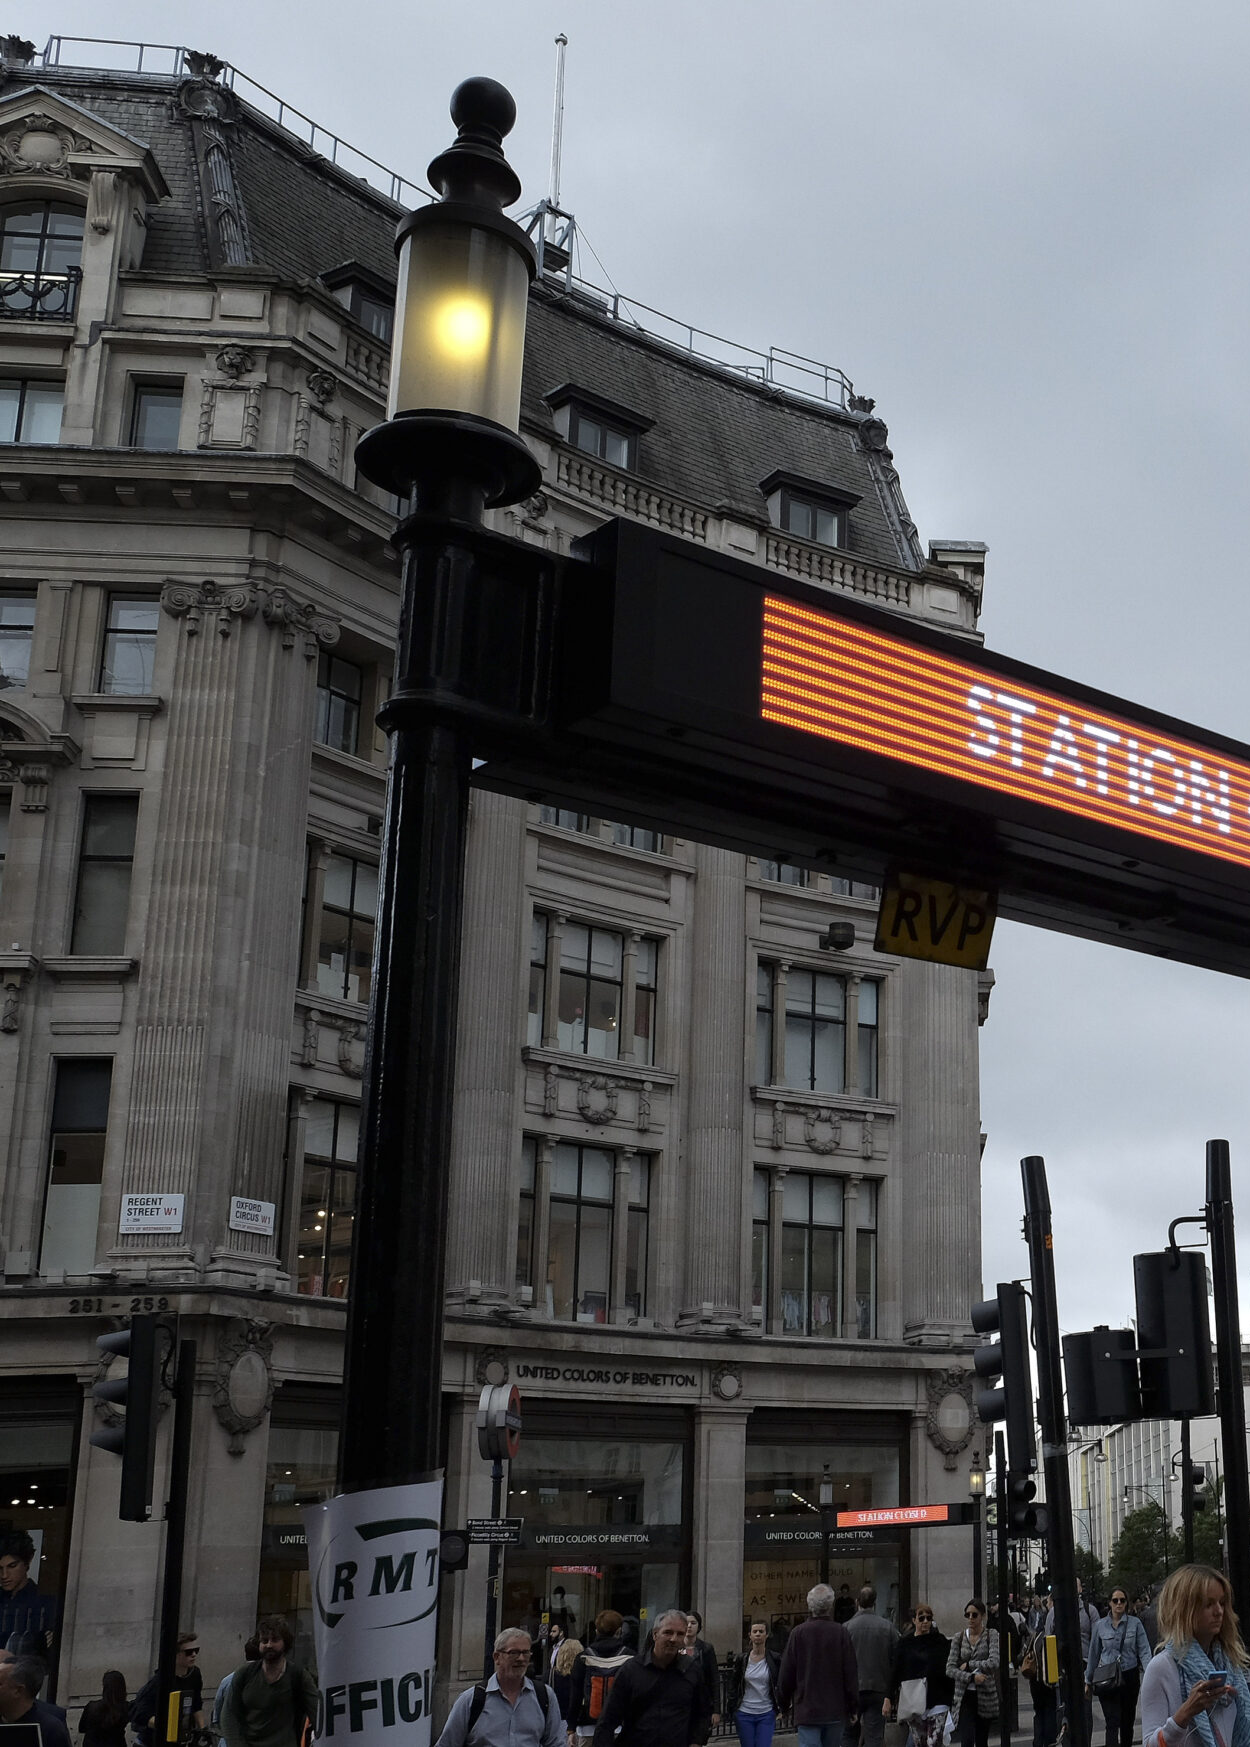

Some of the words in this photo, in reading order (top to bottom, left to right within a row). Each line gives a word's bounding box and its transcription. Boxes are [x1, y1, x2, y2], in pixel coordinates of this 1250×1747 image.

[968, 684, 1231, 834] STATION
[890, 888, 987, 951] RVP
[127, 1197, 163, 1206] REGENT
[236, 1200, 262, 1212] OXFORD
[127, 1207, 161, 1216] STREET
[164, 1207, 178, 1216] W1
[235, 1211, 259, 1222] CIRCUS
[261, 1214, 271, 1224] W1
[69, 1298, 103, 1313] 251
[130, 1297, 168, 1312] 259
[516, 1365, 560, 1380] UNITED
[563, 1368, 611, 1384] COLORS
[613, 1371, 630, 1385] OF
[535, 1534, 564, 1544] UNITED
[566, 1534, 597, 1544] COLORS
[599, 1534, 610, 1543] OF
[766, 1532, 793, 1541] UNITED
[750, 1595, 766, 1605] AS
